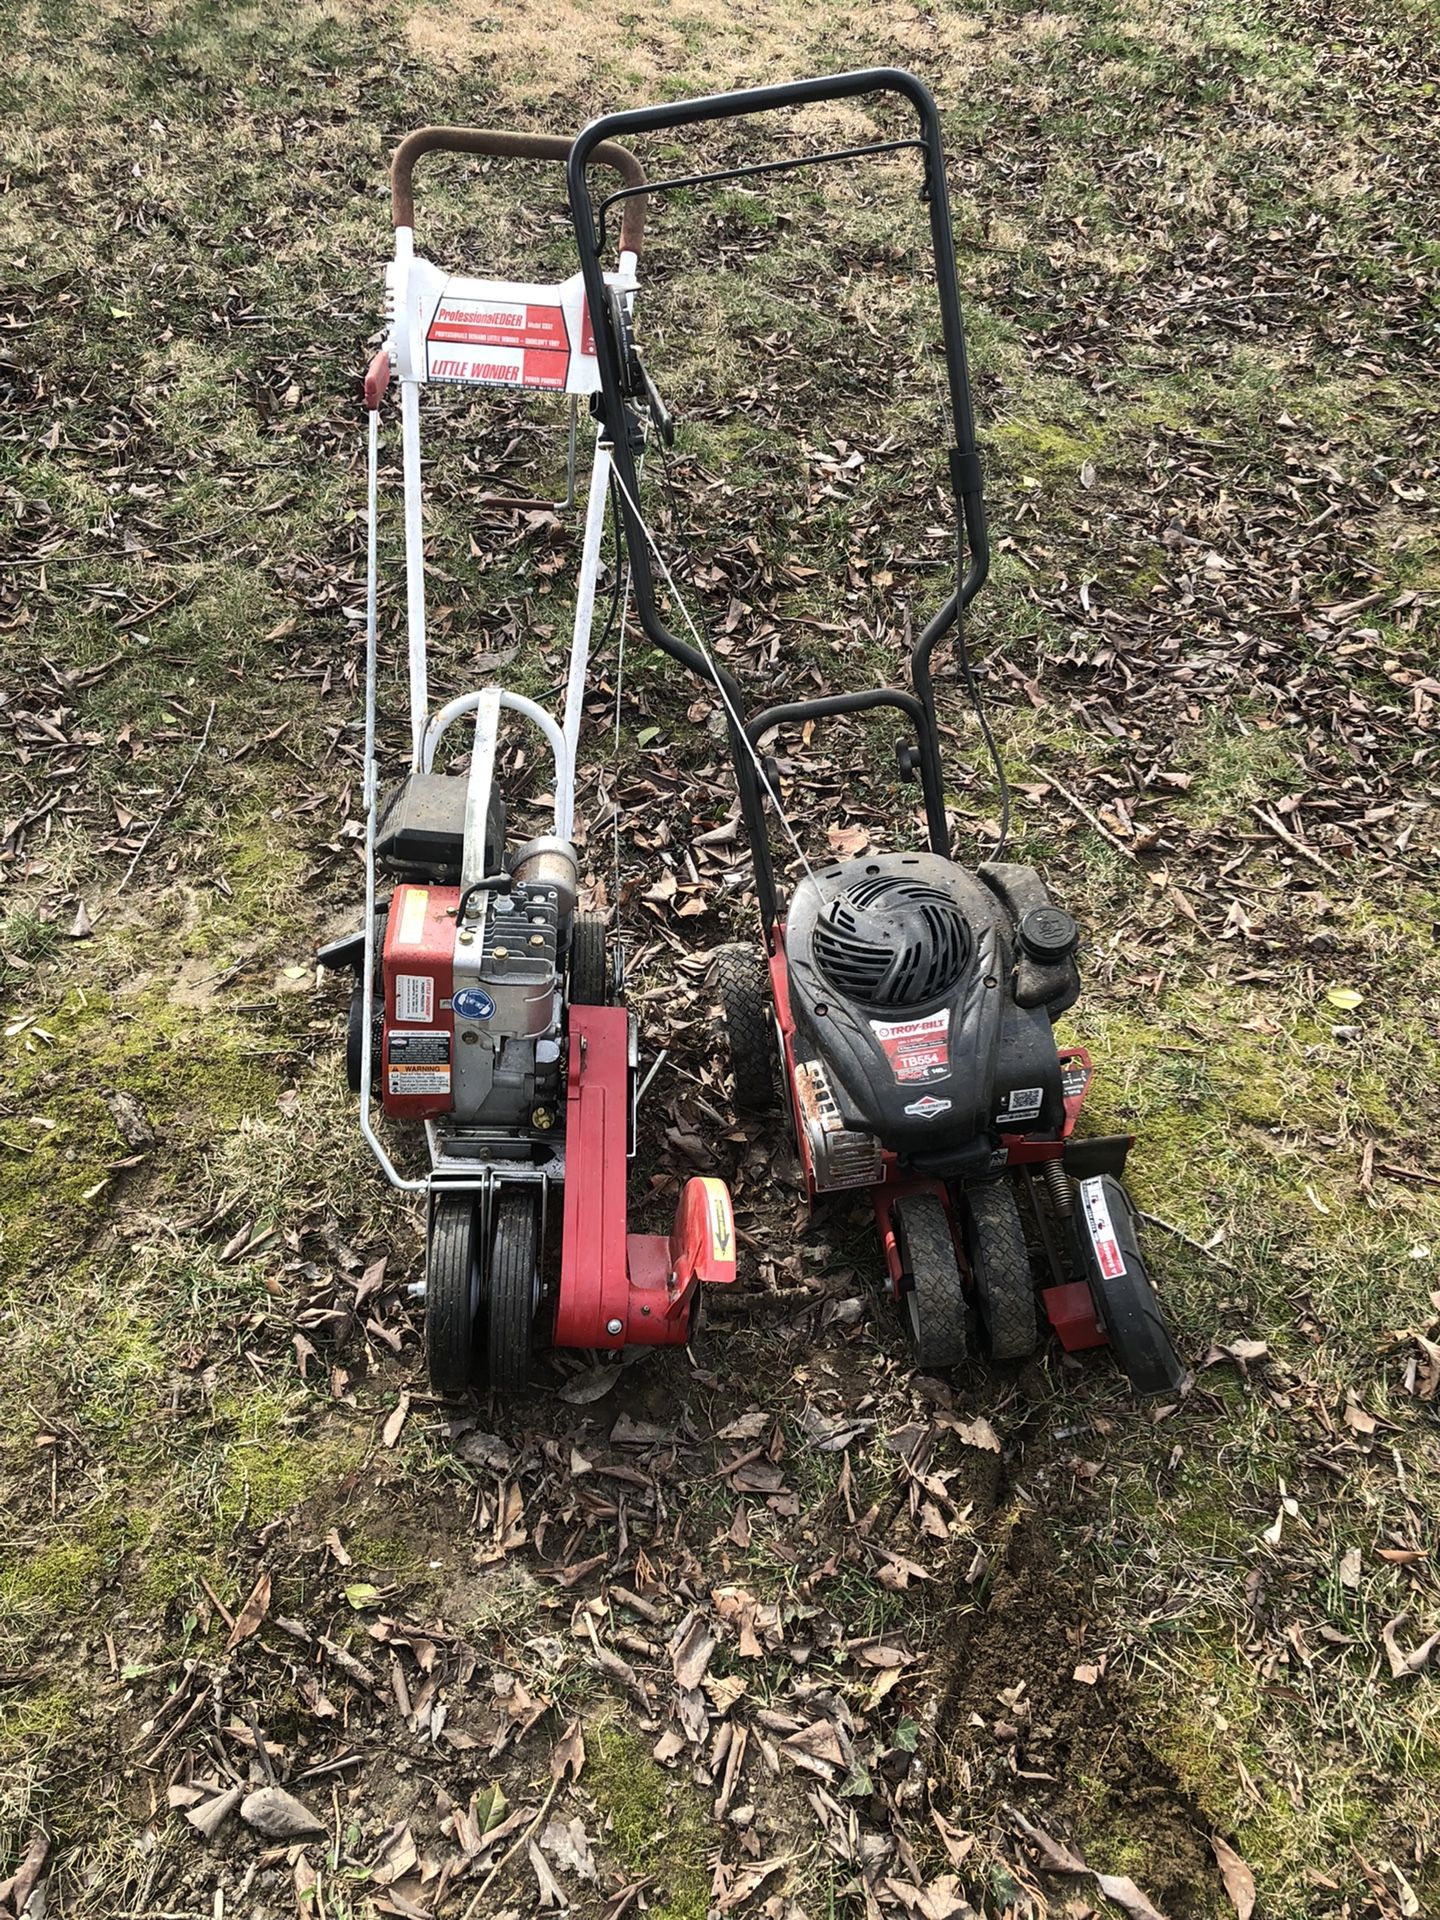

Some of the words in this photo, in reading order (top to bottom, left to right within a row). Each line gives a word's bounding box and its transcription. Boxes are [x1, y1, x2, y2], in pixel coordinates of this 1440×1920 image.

[431, 359, 469, 377] LITTLE
[470, 362, 520, 381] WONDER
[890, 1019, 945, 1036] TROY-BILT
[901, 1053, 939, 1068] TB554
